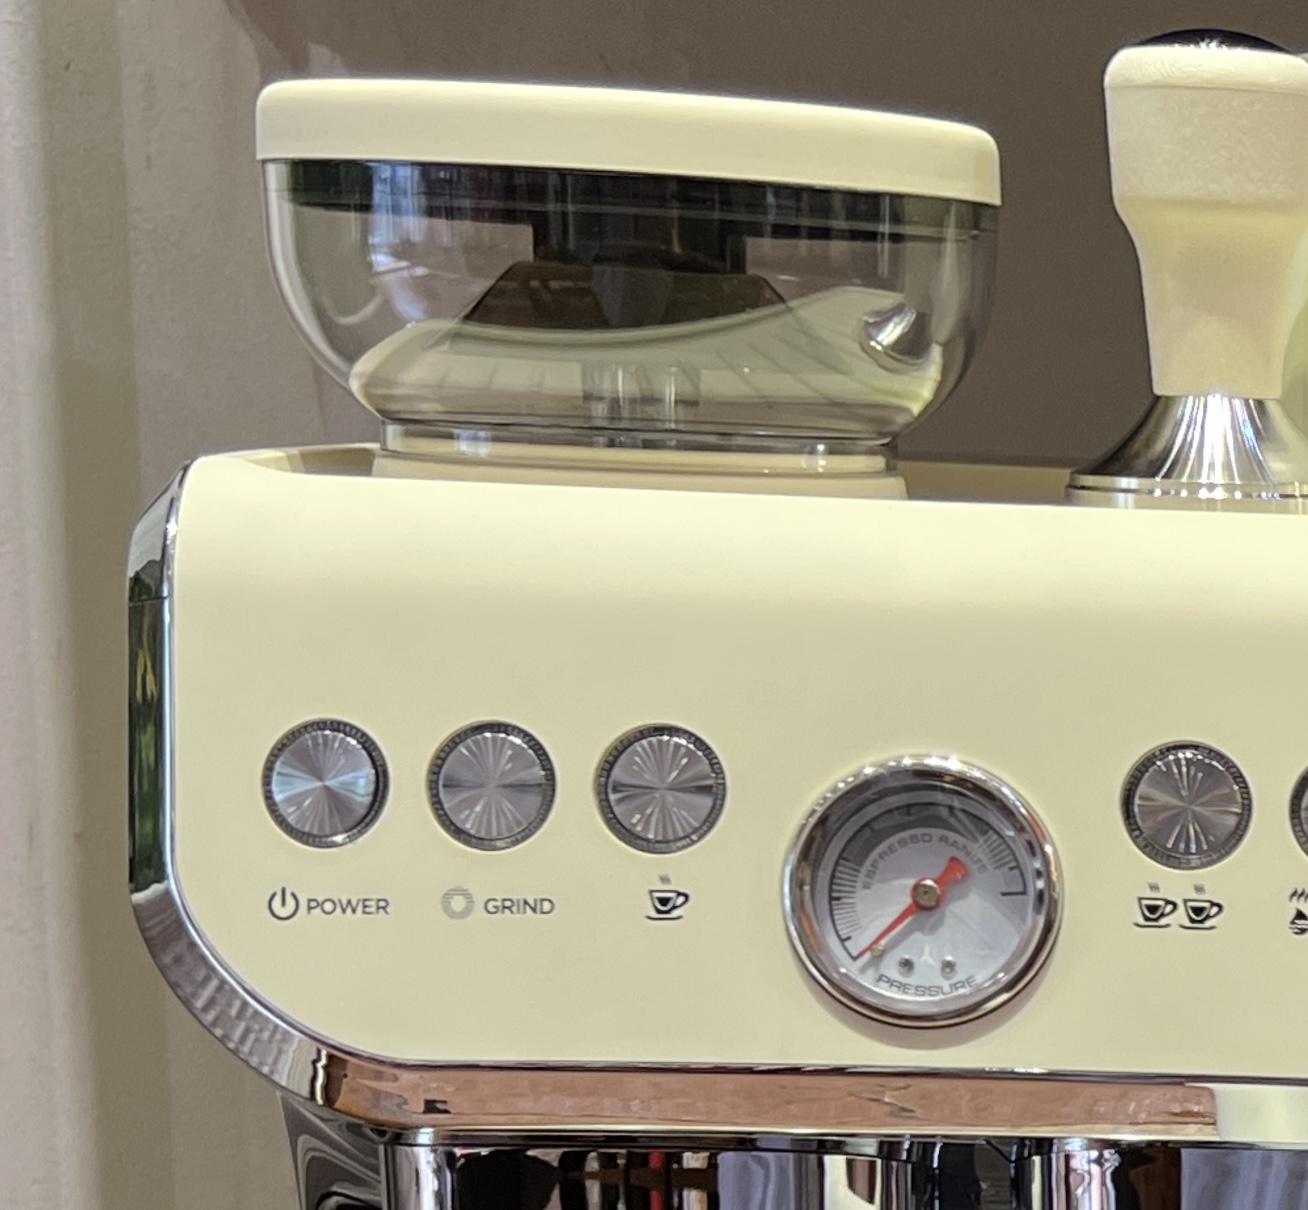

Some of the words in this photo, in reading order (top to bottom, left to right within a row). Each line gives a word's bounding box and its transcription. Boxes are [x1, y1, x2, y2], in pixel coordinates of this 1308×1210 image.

[862, 832, 933, 890] ESPRESSO
[938, 834, 988, 875] RANGE
[306, 897, 390, 916] POWER
[483, 897, 556, 916] GRIND
[876, 974, 978, 996] PRESSURE
